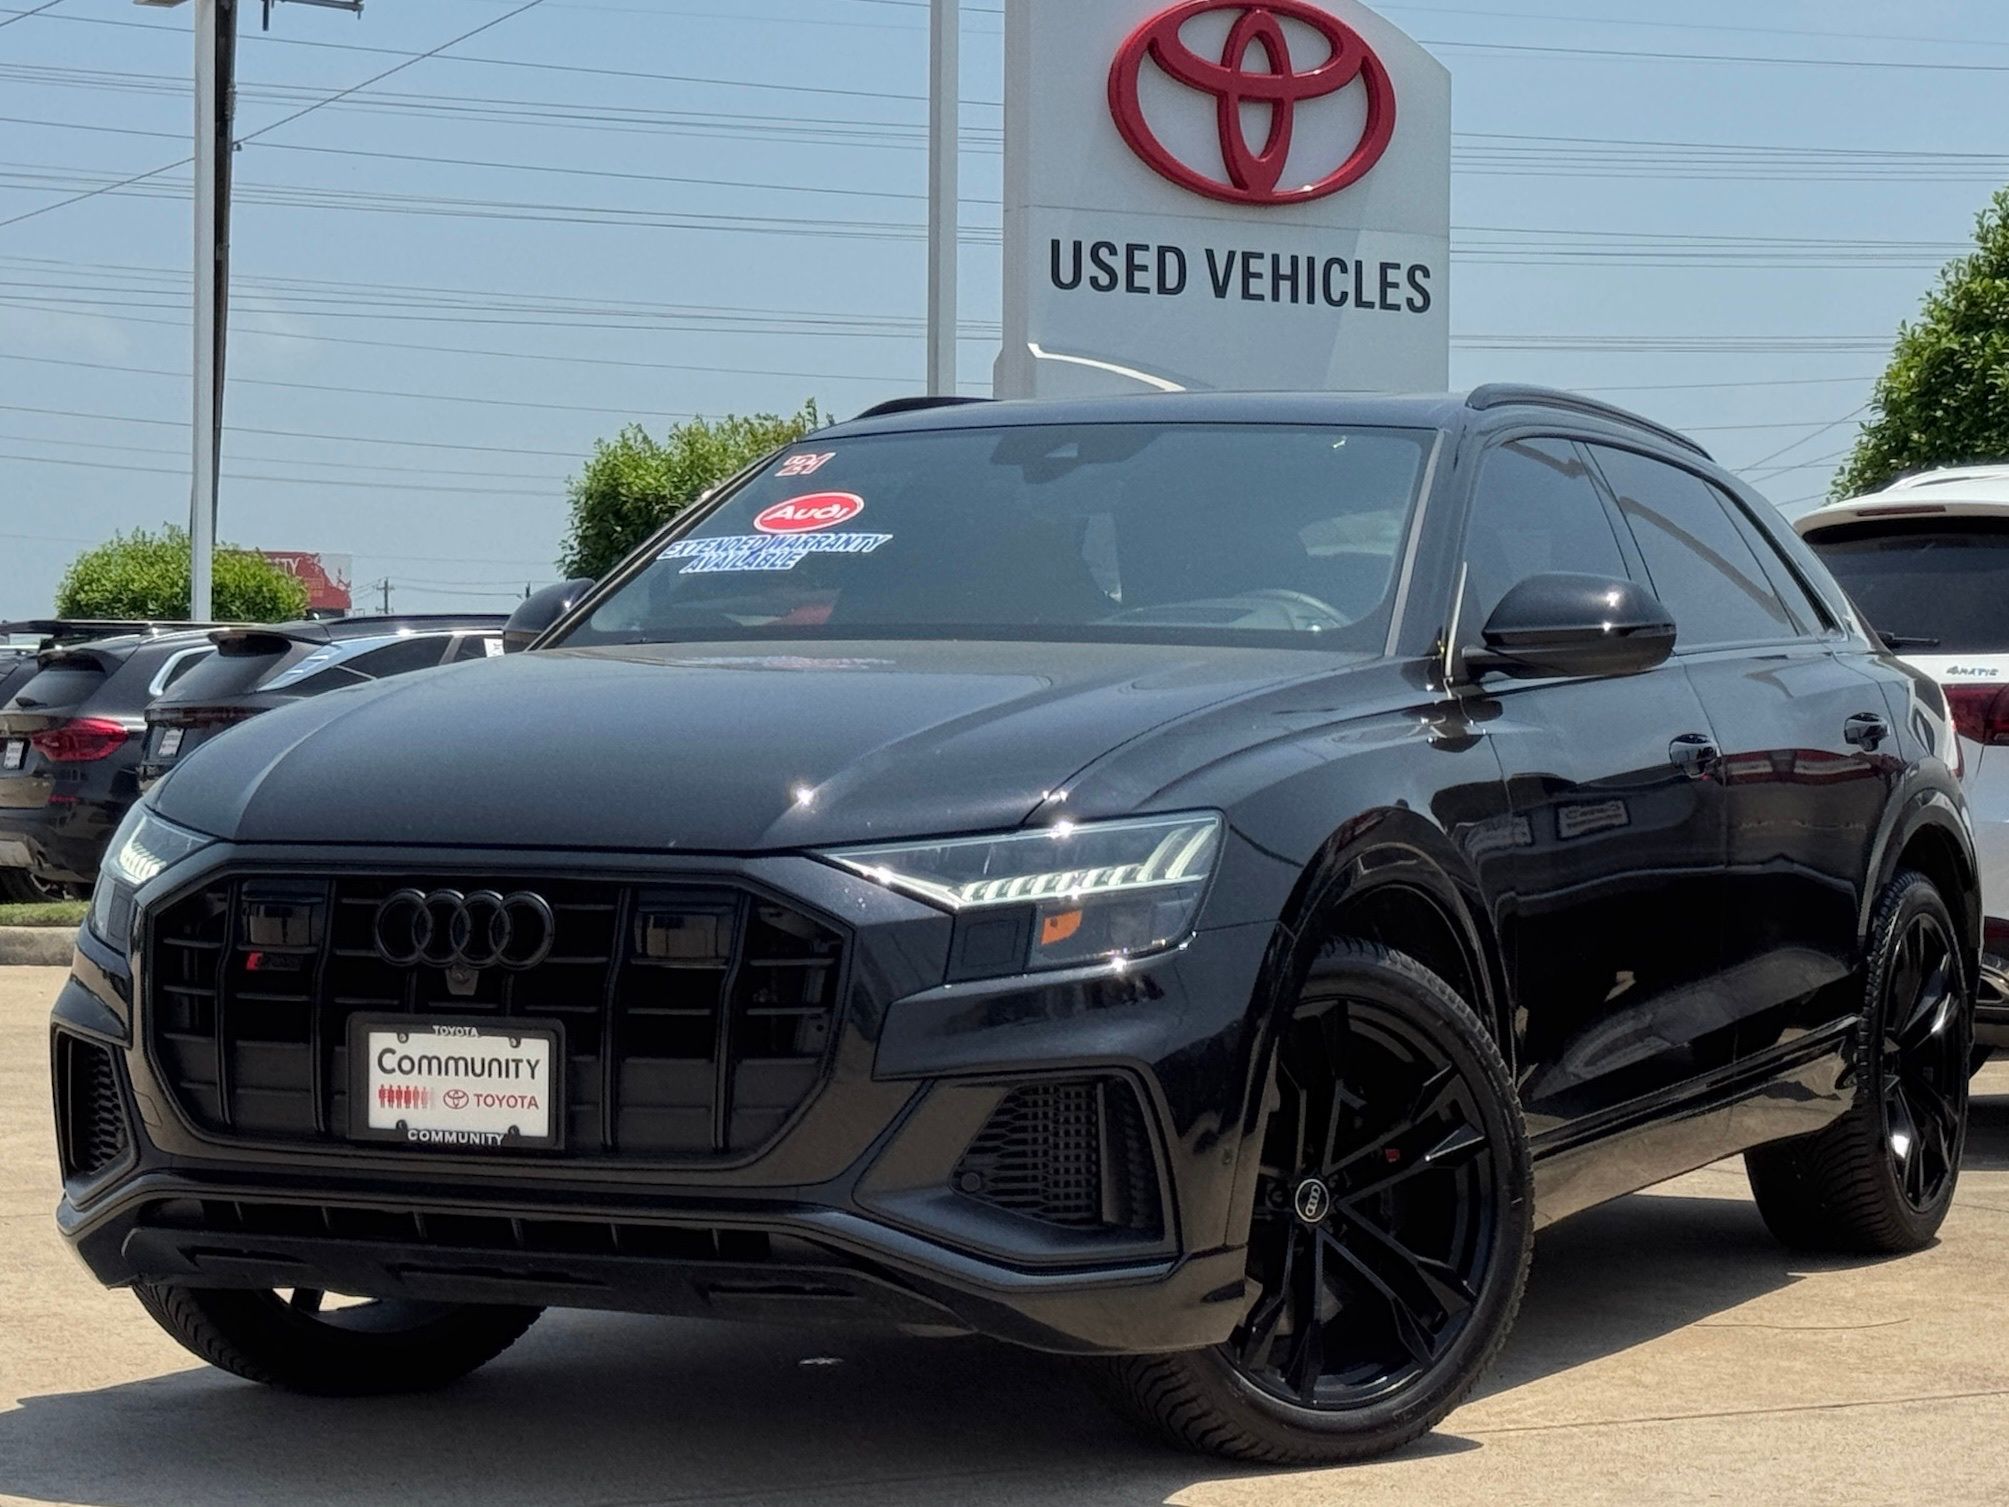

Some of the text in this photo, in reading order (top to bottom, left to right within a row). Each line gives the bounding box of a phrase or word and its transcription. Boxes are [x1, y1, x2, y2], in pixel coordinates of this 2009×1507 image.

[1051, 239, 1431, 314] USED VEHICLES
[763, 502, 850, 521] Audi
[657, 533, 893, 560] EXTENDED WARRANTY
[679, 551, 809, 574] AVAILABLE
[432, 1024, 479, 1037] TOYOTA
[473, 1092, 540, 1110] TOYOTA
[407, 1129, 505, 1146] COMMUNITY
